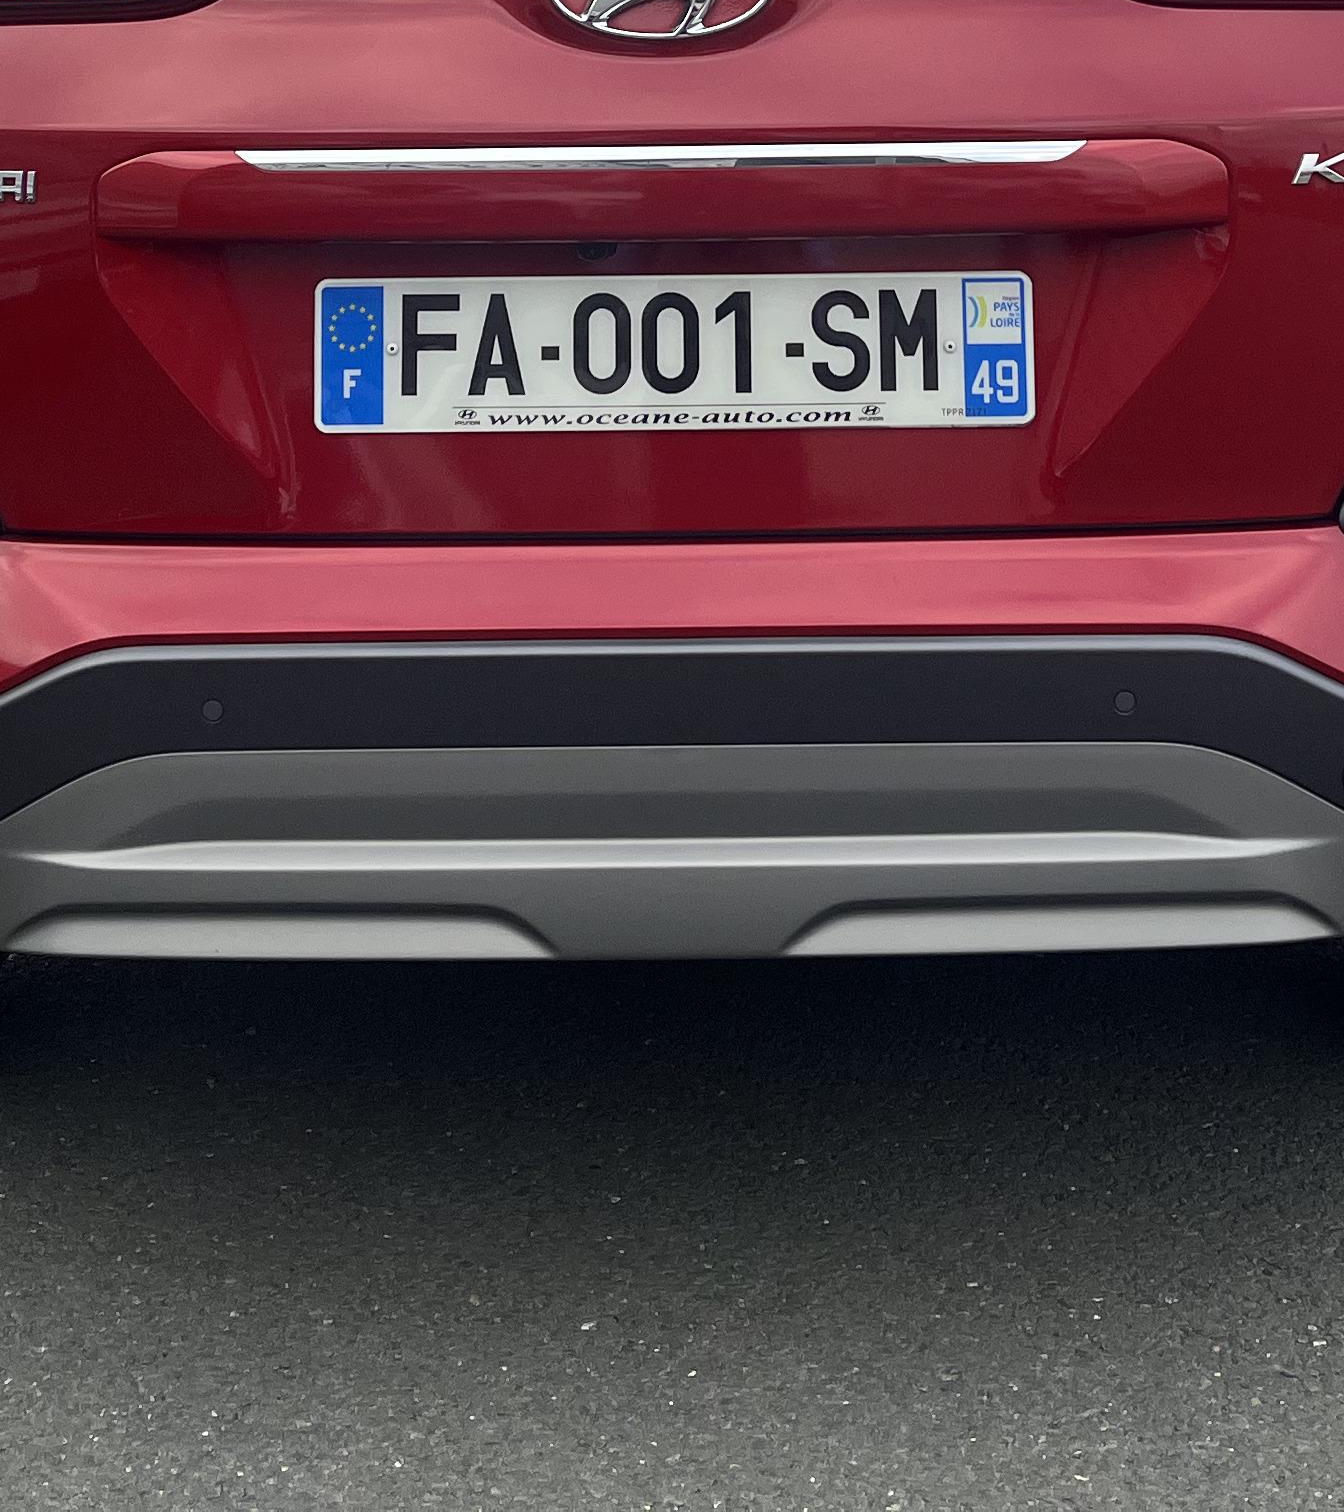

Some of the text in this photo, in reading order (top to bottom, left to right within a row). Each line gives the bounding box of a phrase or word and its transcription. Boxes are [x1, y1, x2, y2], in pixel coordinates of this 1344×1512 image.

[993, 301, 1020, 312] PAYS
[990, 317, 1021, 328] LOIRE
[400, 288, 940, 397] FA-001-SM
[343, 369, 362, 399] F
[971, 359, 1019, 404] 49
[488, 407, 852, 426] www.oceane-auto.com
